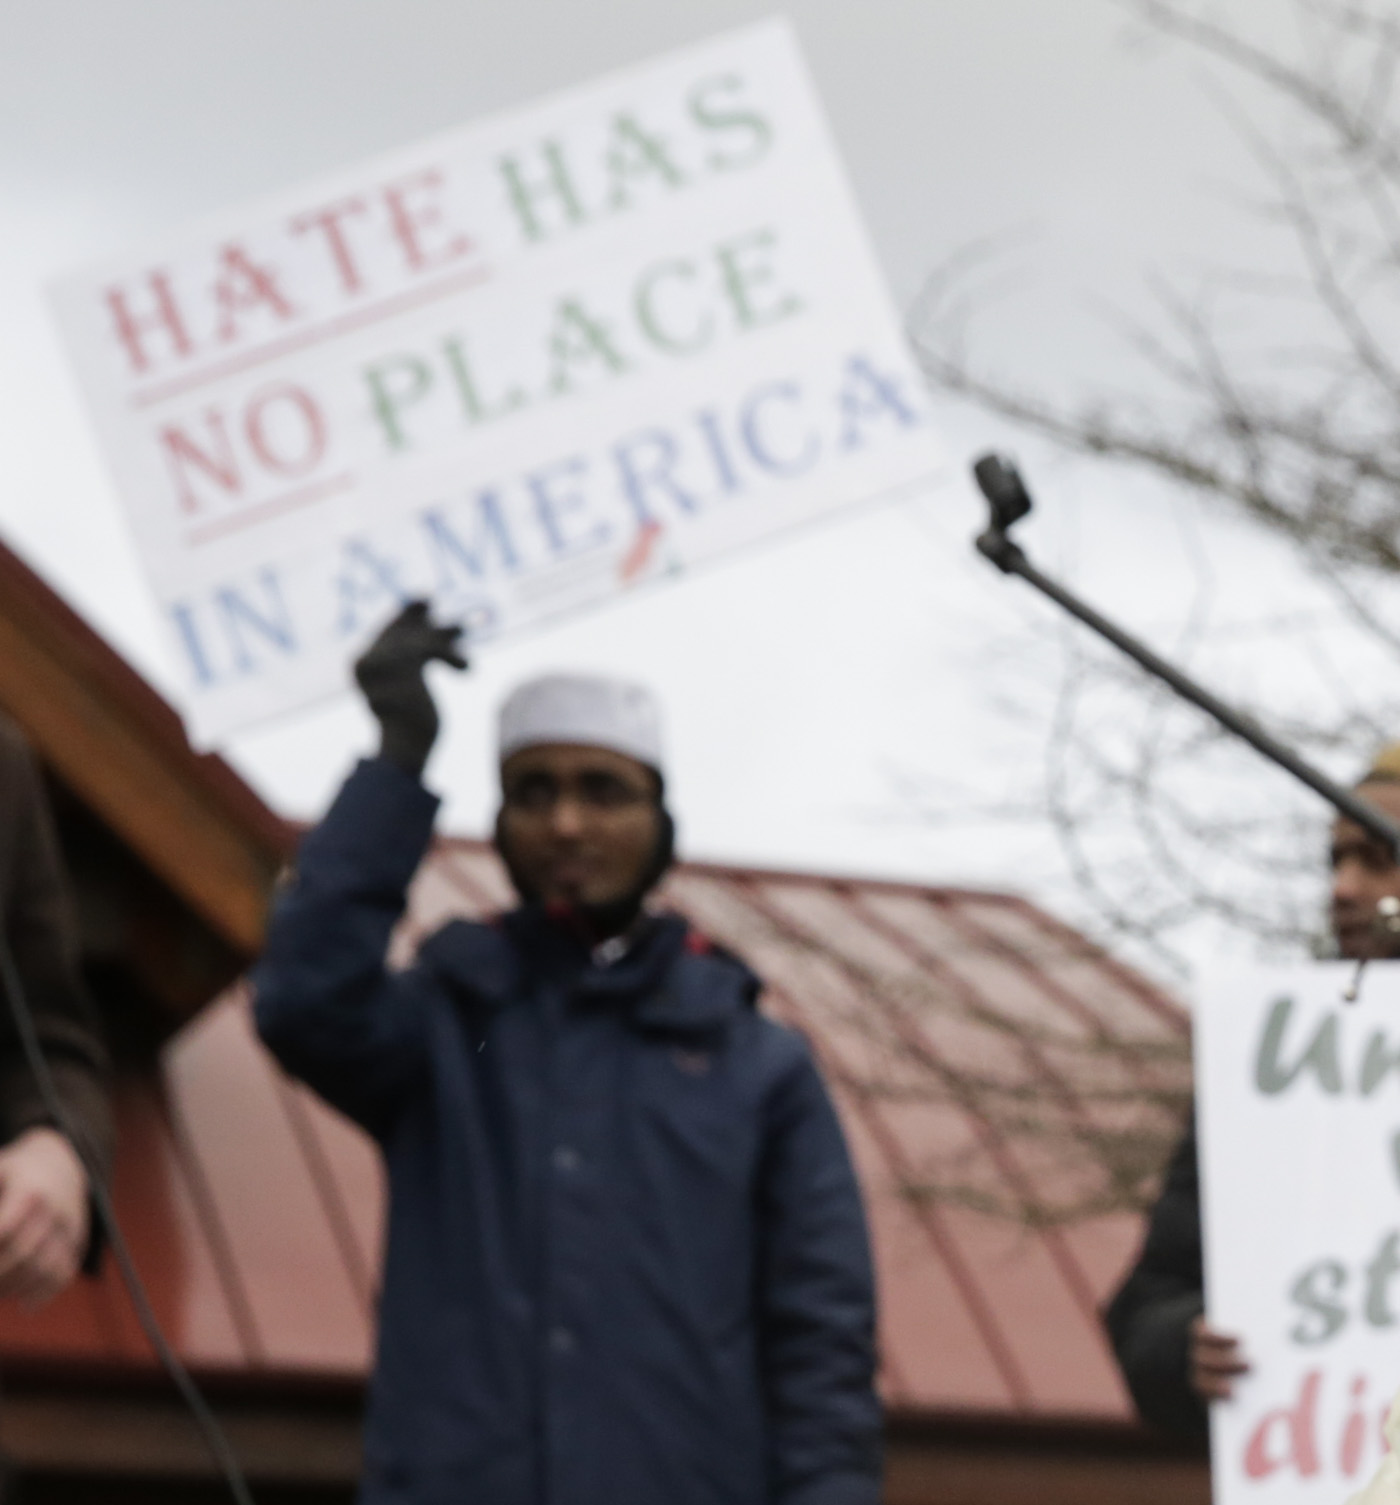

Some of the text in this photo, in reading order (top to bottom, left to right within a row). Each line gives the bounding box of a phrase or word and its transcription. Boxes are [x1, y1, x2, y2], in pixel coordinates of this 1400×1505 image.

[102, 71, 777, 376] HATE HAS
[160, 228, 806, 516] NO PLACE
[171, 350, 924, 690] IN AMERICA
